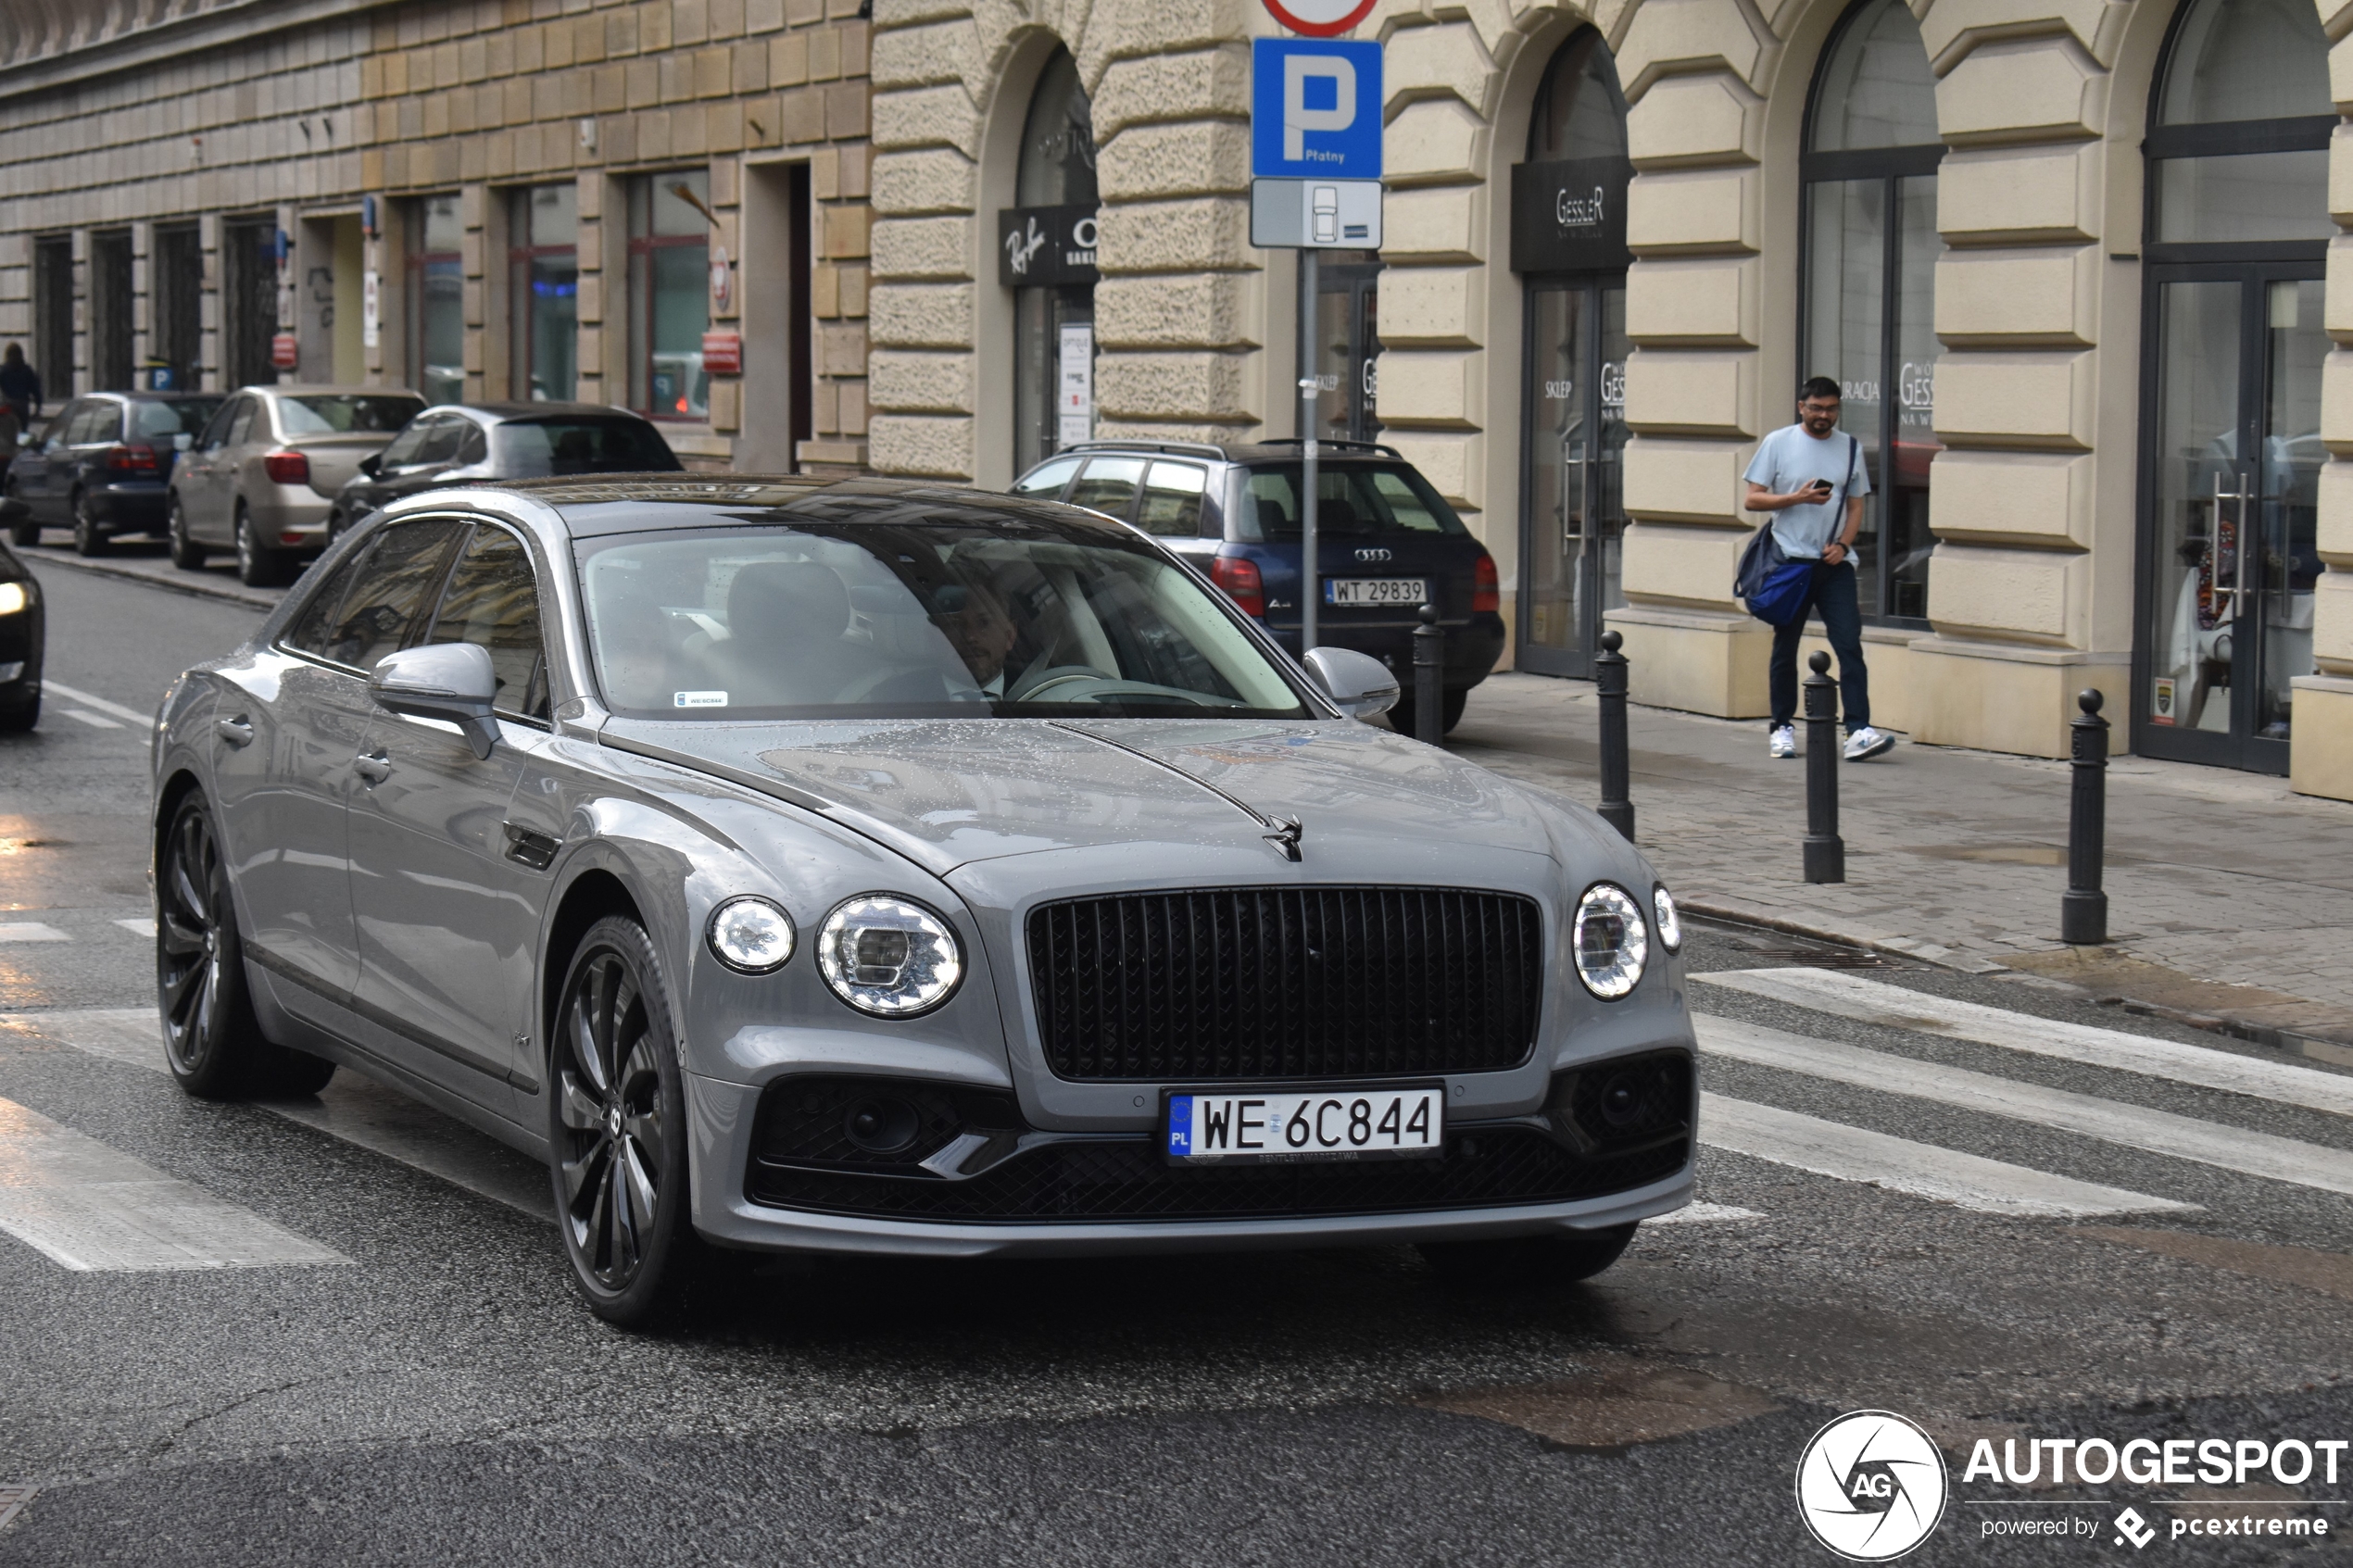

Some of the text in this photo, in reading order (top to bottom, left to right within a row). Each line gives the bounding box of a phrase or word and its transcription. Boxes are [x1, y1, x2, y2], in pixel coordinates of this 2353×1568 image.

[1283, 54, 1357, 161] P
[1305, 148, 1345, 165] Płatny
[1556, 186, 1604, 224] GESSLER
[1544, 381, 1572, 399] SKLEP
[1900, 413, 1916, 426] NA
[1337, 582, 1423, 601] WT 29839
[1203, 1096, 1429, 1149] WE 6C844
[1171, 1132, 1189, 1146] PL
[1258, 1151, 1359, 1163] BENTLEY WARSZAWA
